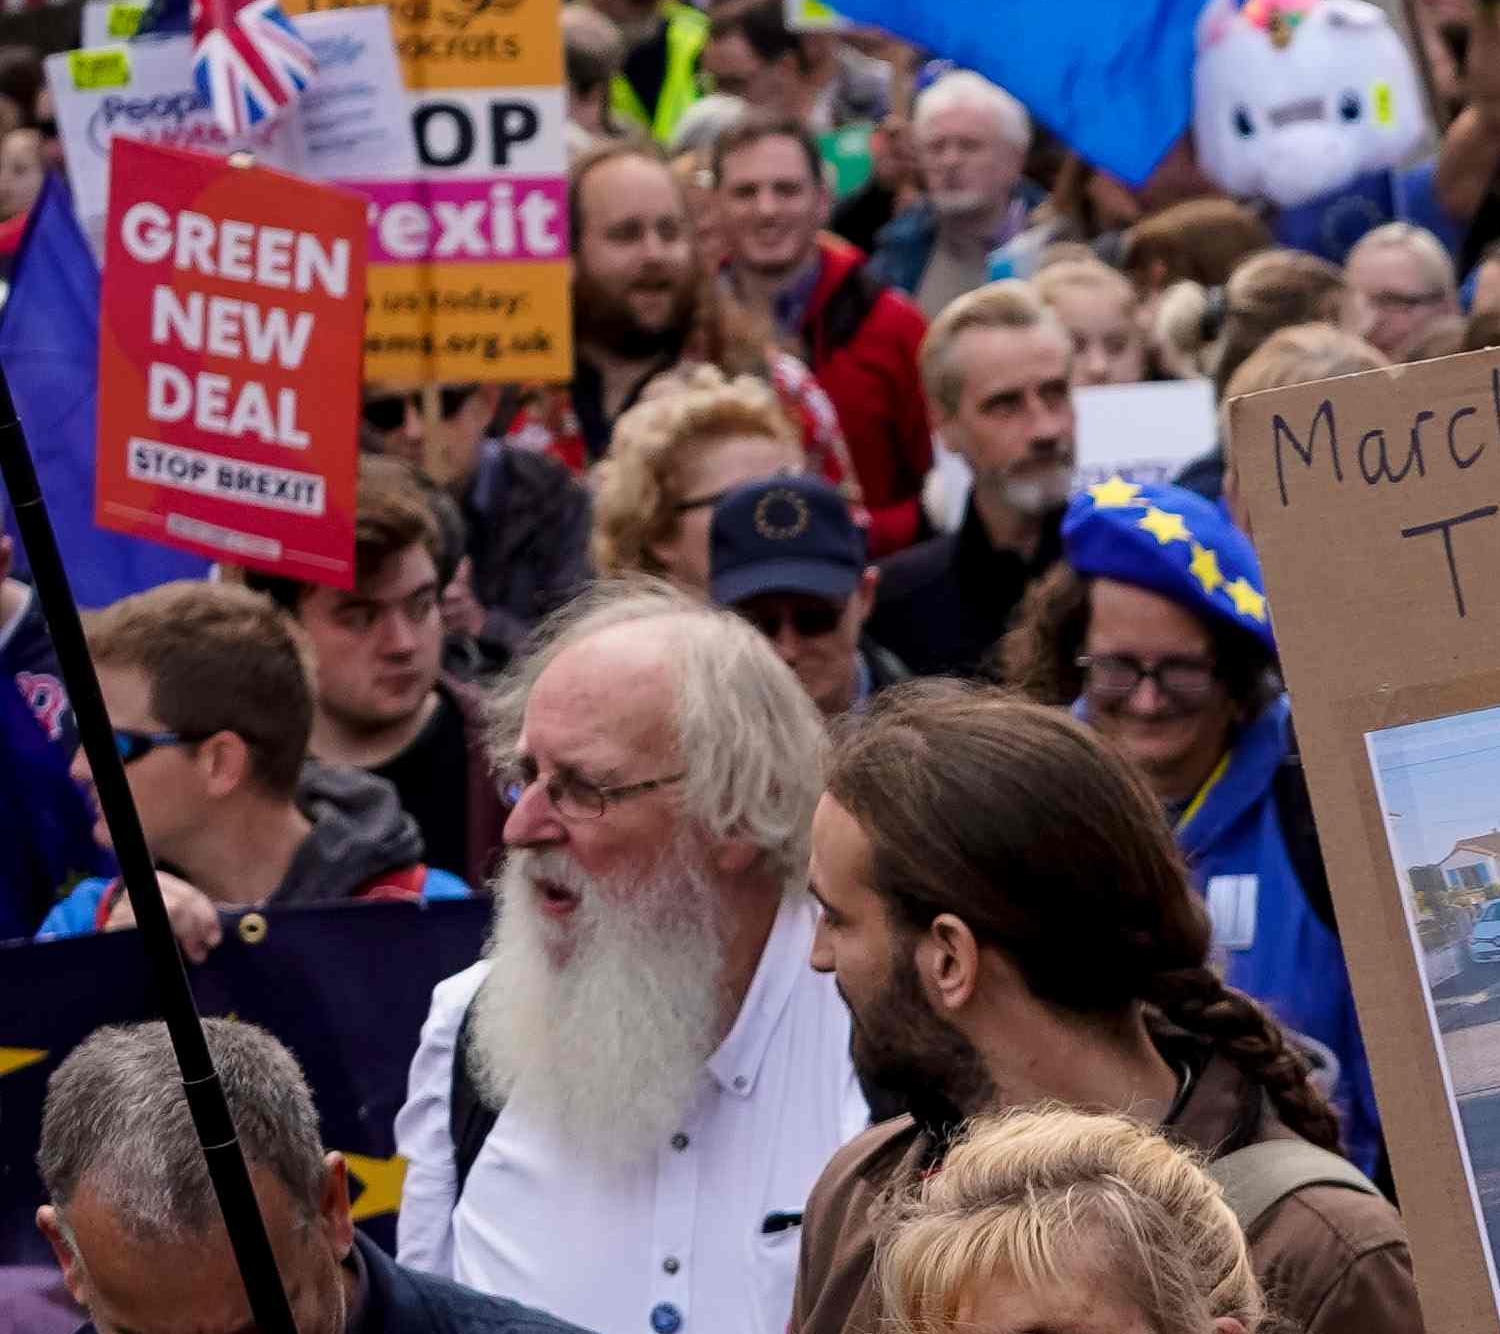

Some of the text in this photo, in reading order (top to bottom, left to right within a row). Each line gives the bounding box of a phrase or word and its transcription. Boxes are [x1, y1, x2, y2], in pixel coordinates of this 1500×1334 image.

[121, 202, 352, 299] GREEN
[150, 284, 314, 368] NEW
[148, 364, 311, 451] DEAL
[135, 448, 317, 506] STOP BREXIT
